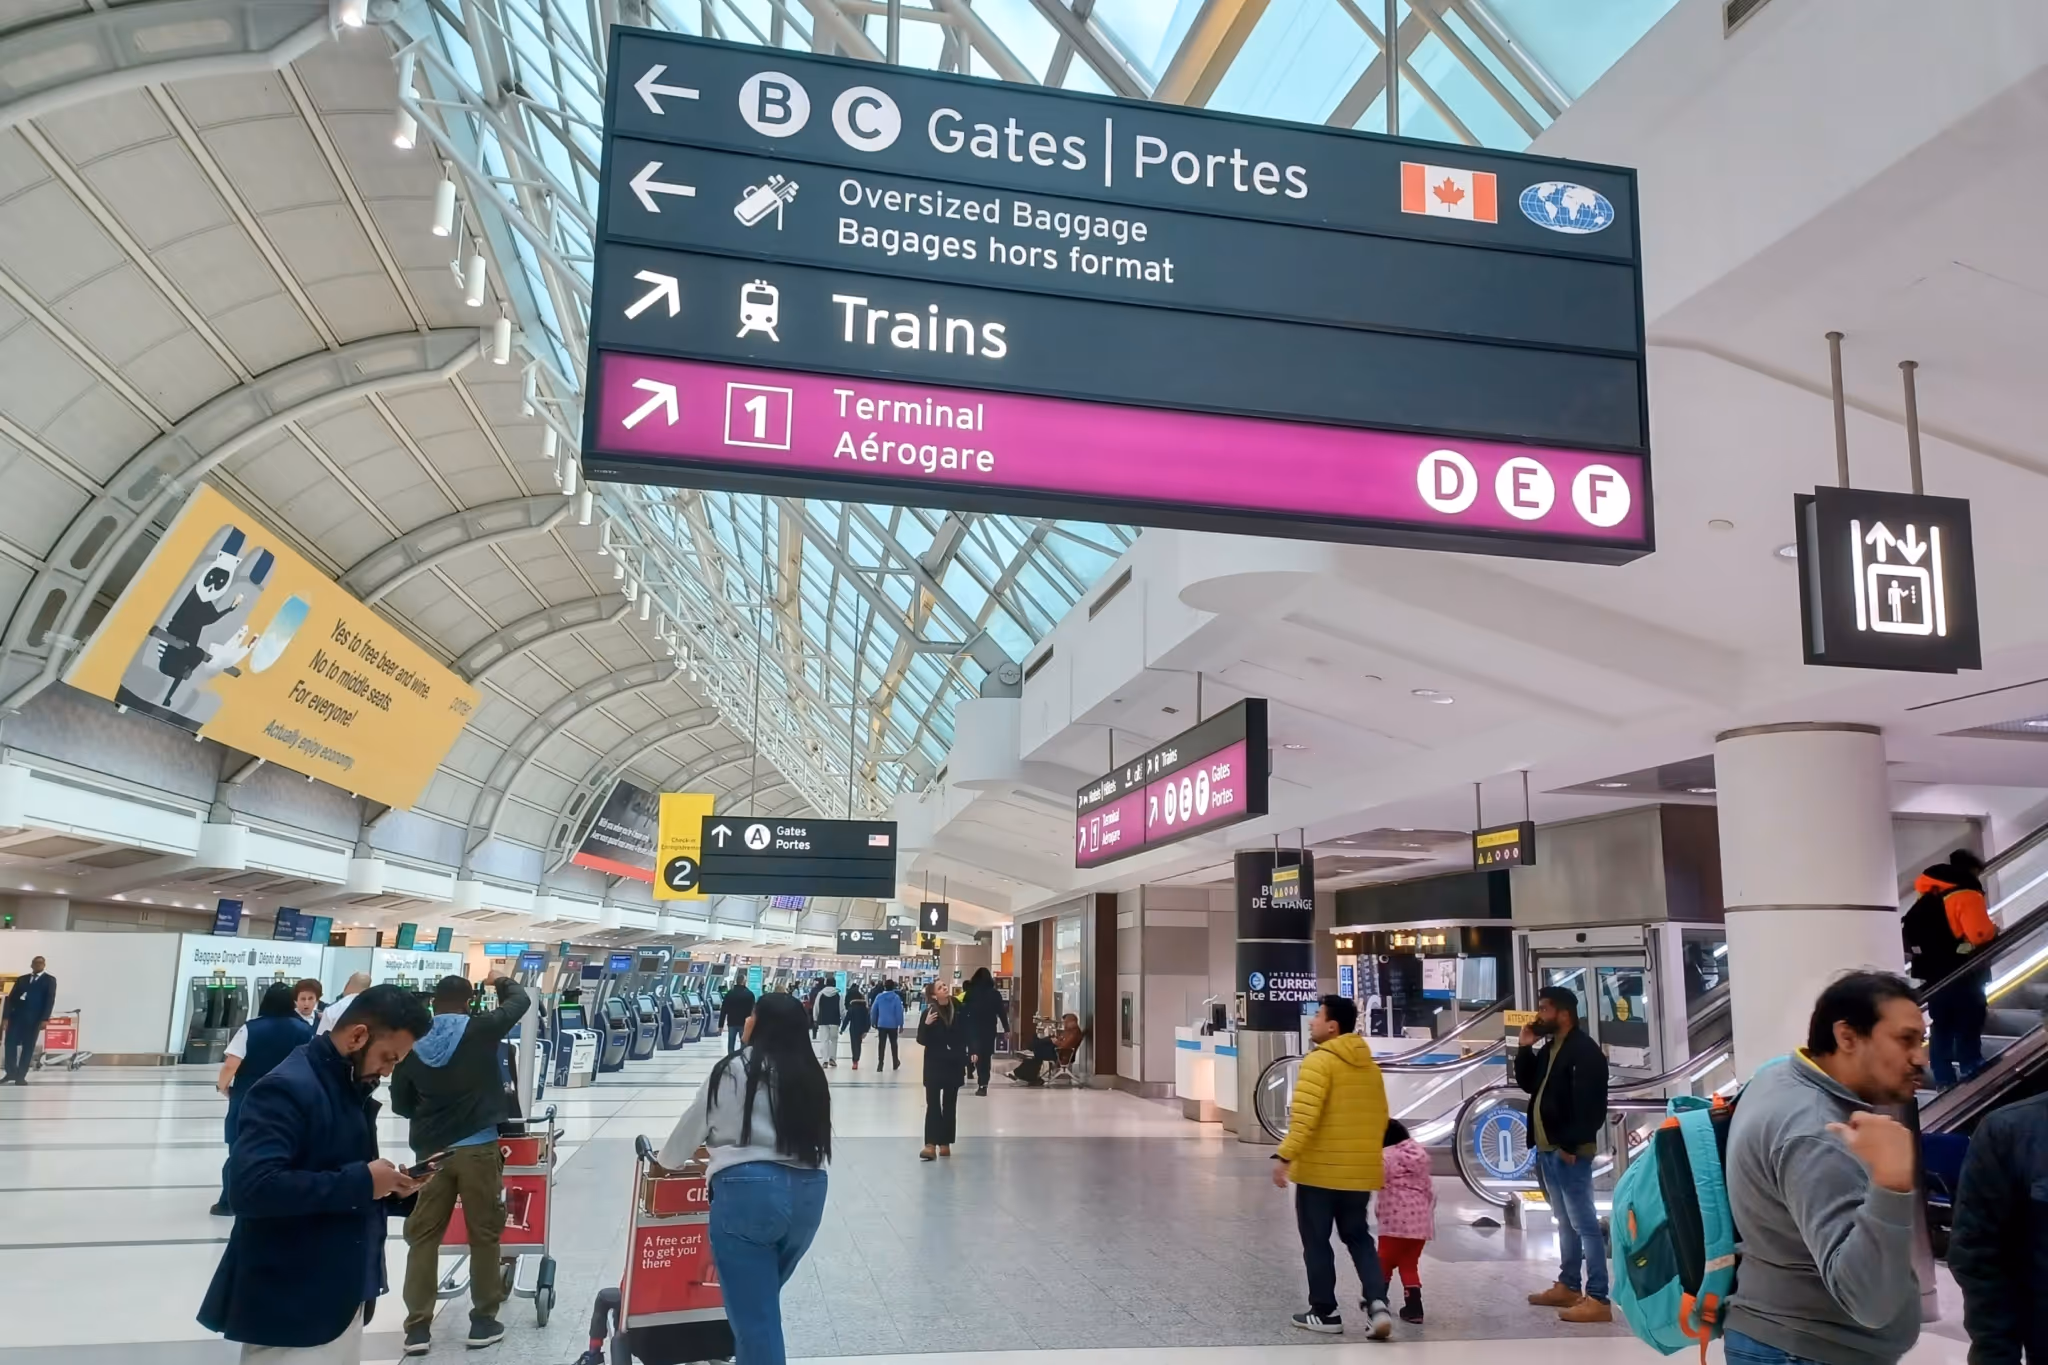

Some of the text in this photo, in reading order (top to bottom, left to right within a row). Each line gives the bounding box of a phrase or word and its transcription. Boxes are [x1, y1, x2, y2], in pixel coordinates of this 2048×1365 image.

[756, 80, 1309, 199] B C Gates Portes
[839, 179, 1148, 246] Oversized Baggage
[838, 219, 1174, 283] Bagages hors format
[832, 294, 1008, 359] Trains
[744, 394, 768, 439] 1
[833, 388, 984, 432] Terminal
[833, 430, 995, 474] Aérogare
[1433, 459, 1614, 514] D E F
[330, 617, 431, 700] Yes to free beer and wine.
[308, 648, 392, 712] No to middle seats.
[287, 679, 359, 728] For everyone!
[262, 719, 300, 749] Actually
[297, 737, 323, 758] enjoy
[1161, 748, 1178, 767] Trains
[1211, 763, 1231, 783] Gates
[1212, 788, 1234, 808] Portes
[1102, 807, 1120, 828] Terminal
[776, 825, 807, 838] Gates
[776, 839, 811, 851] Portes
[672, 860, 692, 886] 2
[1252, 897, 1268, 909] DE
[194, 948, 222, 966] Baggage
[222, 949, 247, 965] Drop-off
[1249, 990, 1266, 1001] ice
[642, 1246, 697, 1260] to get you
[644, 1233, 702, 1247] A free cart
[641, 1258, 671, 1269] there
